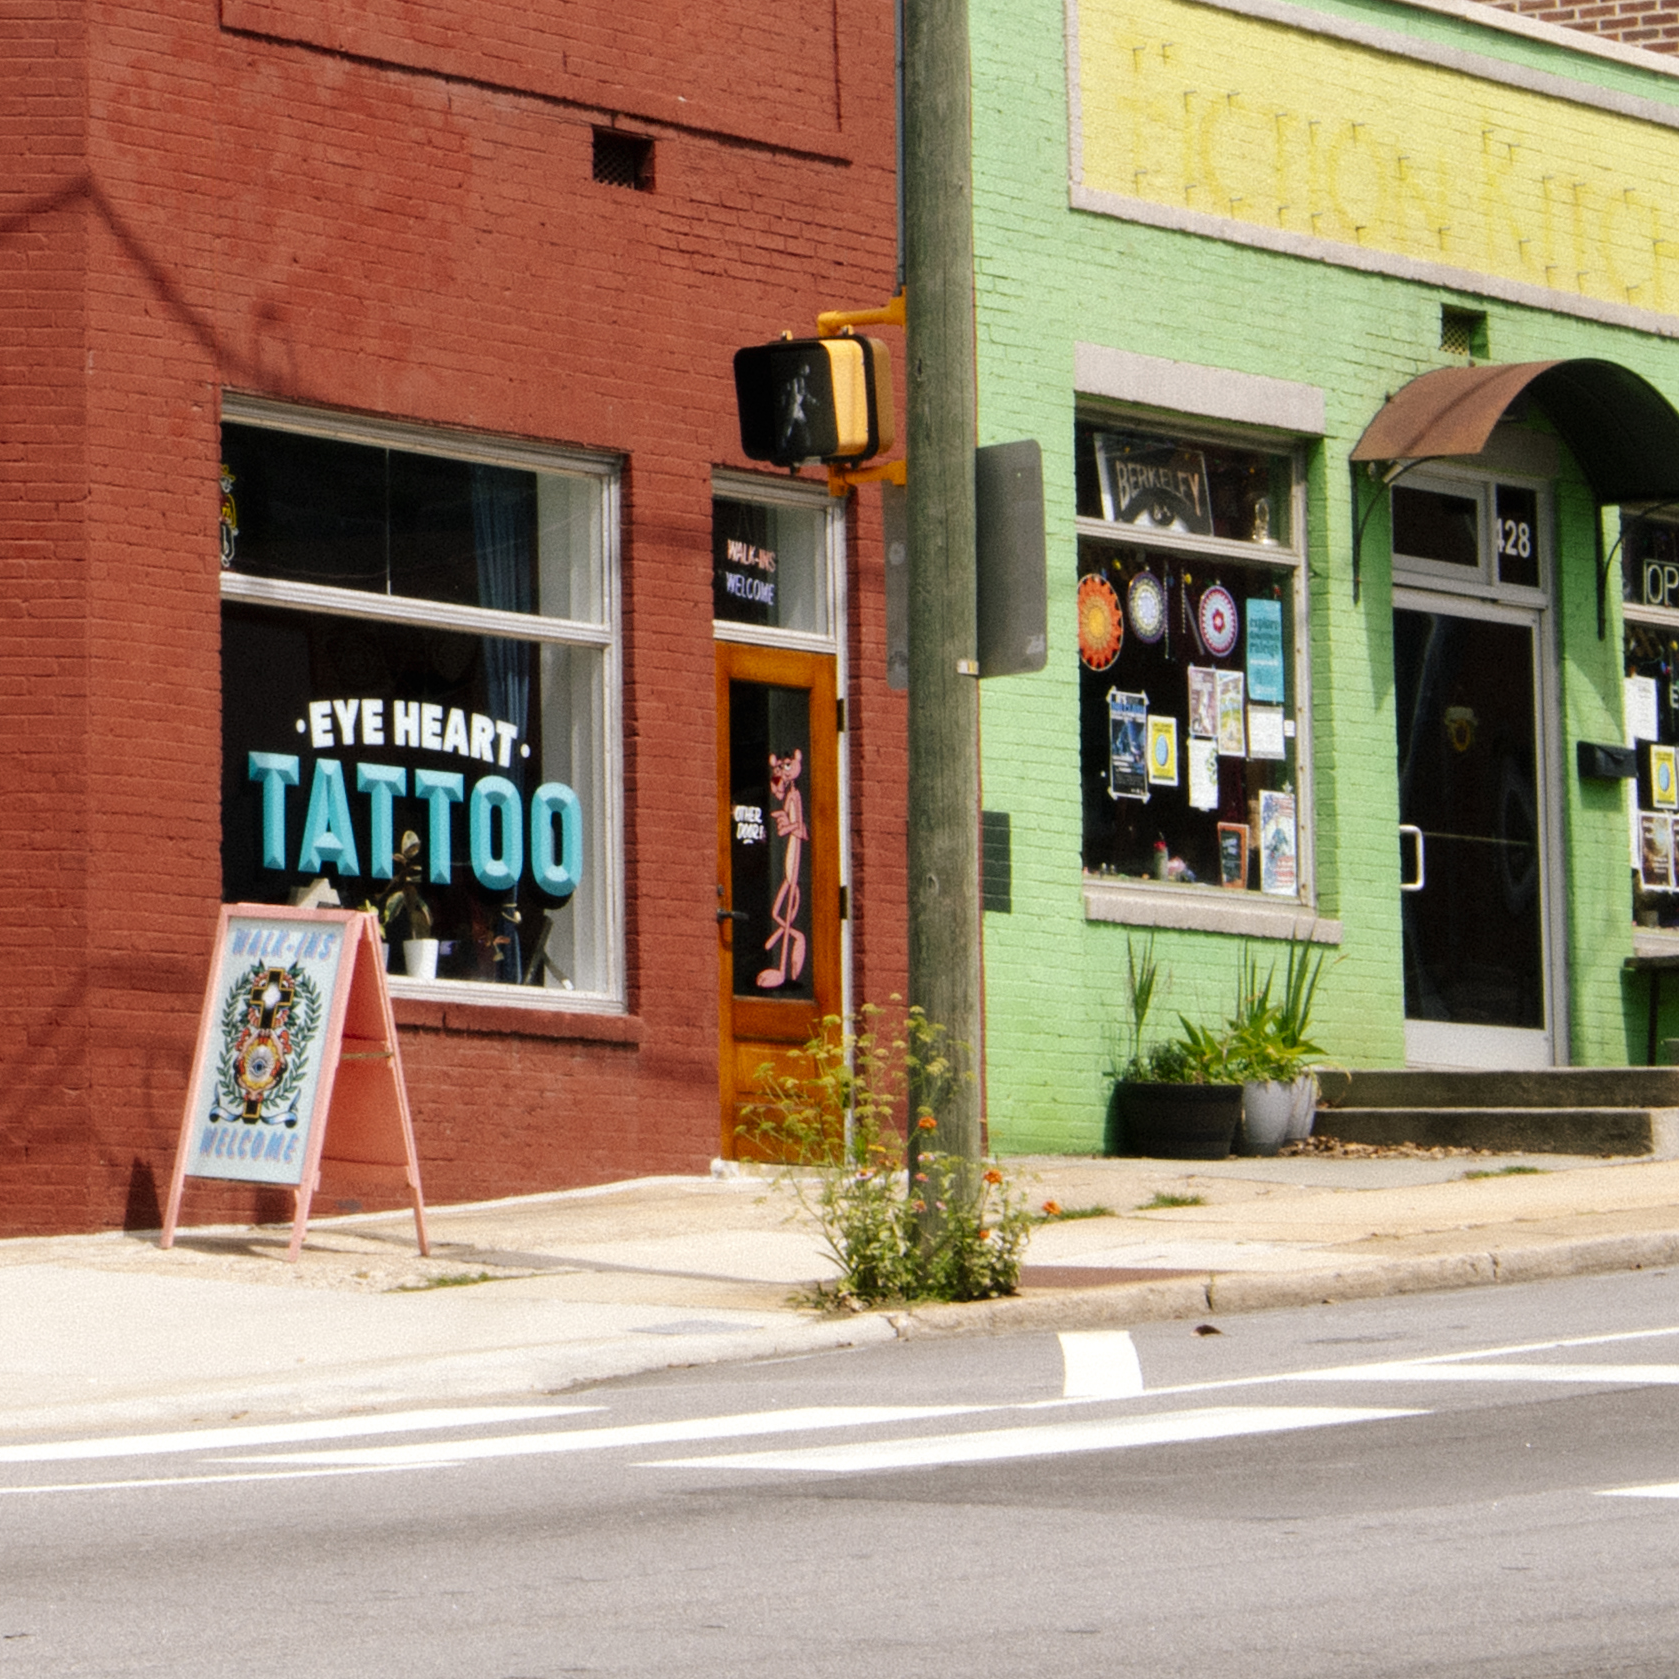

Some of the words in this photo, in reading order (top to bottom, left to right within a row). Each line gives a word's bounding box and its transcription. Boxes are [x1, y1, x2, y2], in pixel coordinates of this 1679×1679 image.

[1115, 460, 1202, 517] BERKELEY
[727, 538, 777, 574] WALK-INS
[725, 571, 775, 606] WELCOME
[308, 698, 384, 749] EYE
[393, 699, 518, 768] HEART
[248, 751, 583, 897] TATTOO
[734, 805, 762, 823] OTHER
[199, 1127, 301, 1165] WELCOME
